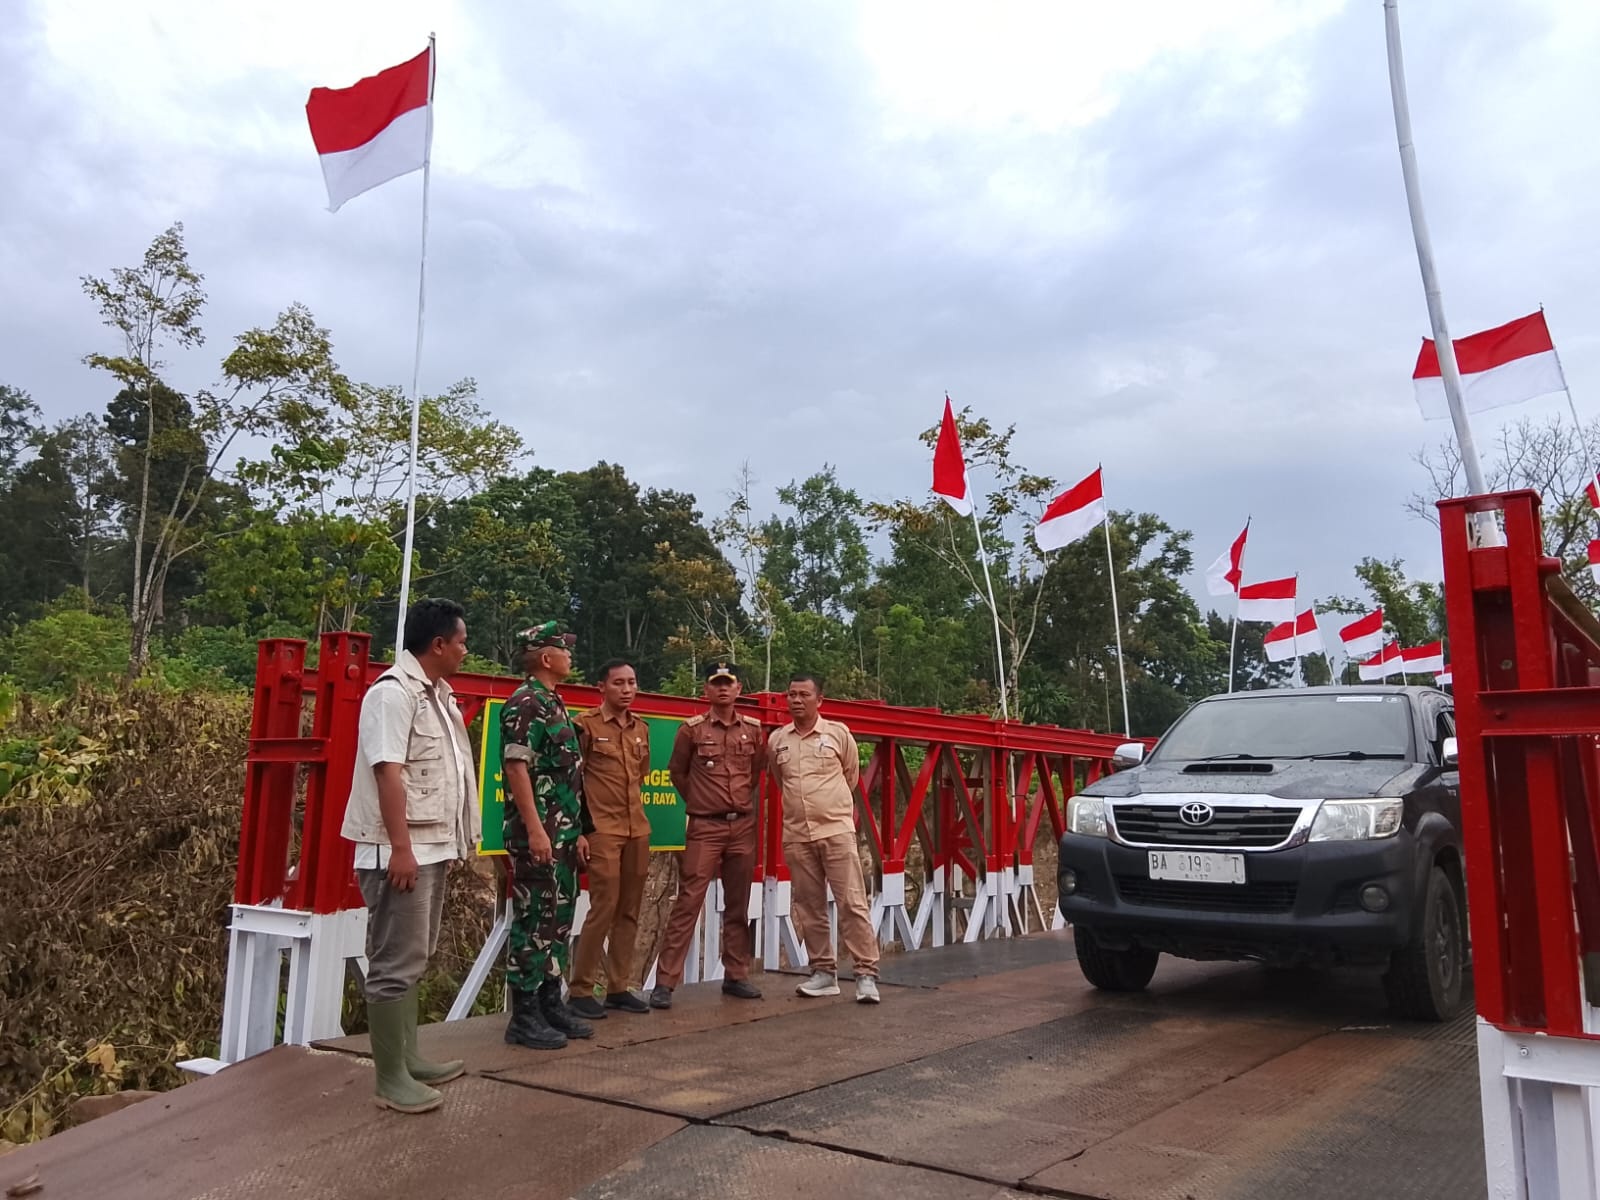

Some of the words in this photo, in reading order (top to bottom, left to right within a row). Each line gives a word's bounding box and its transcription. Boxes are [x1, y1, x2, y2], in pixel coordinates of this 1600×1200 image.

[653, 792, 676, 805] RAYA
[1151, 854, 1167, 870] BA
[1231, 857, 1239, 873] T
